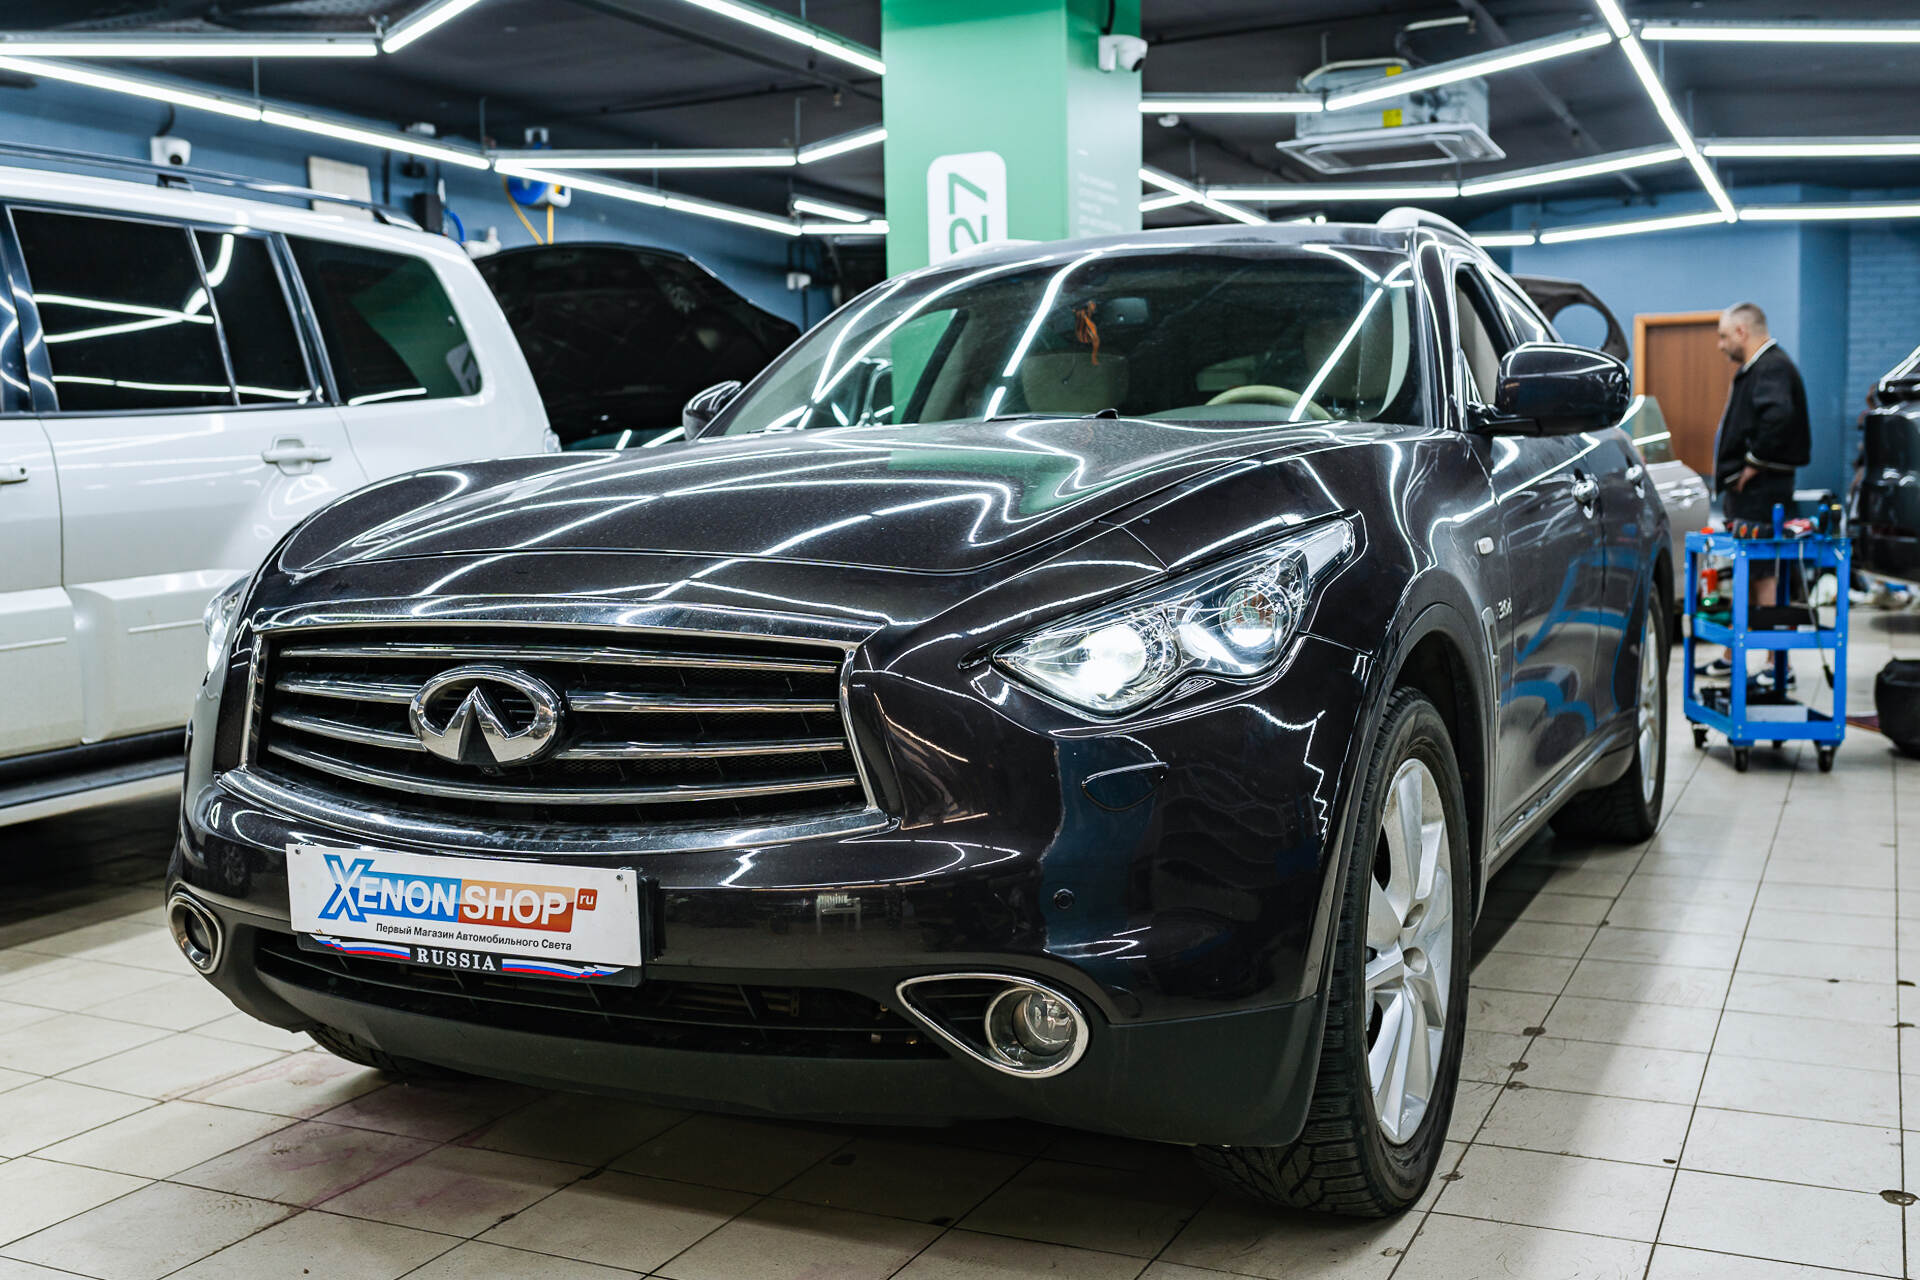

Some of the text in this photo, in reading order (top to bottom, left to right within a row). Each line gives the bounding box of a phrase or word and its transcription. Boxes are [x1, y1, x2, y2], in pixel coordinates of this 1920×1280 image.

[579, 894, 594, 906] ru
[376, 923, 572, 951] Первый Магазин Автомобильного Света
[416, 948, 497, 971] RUSSIA
